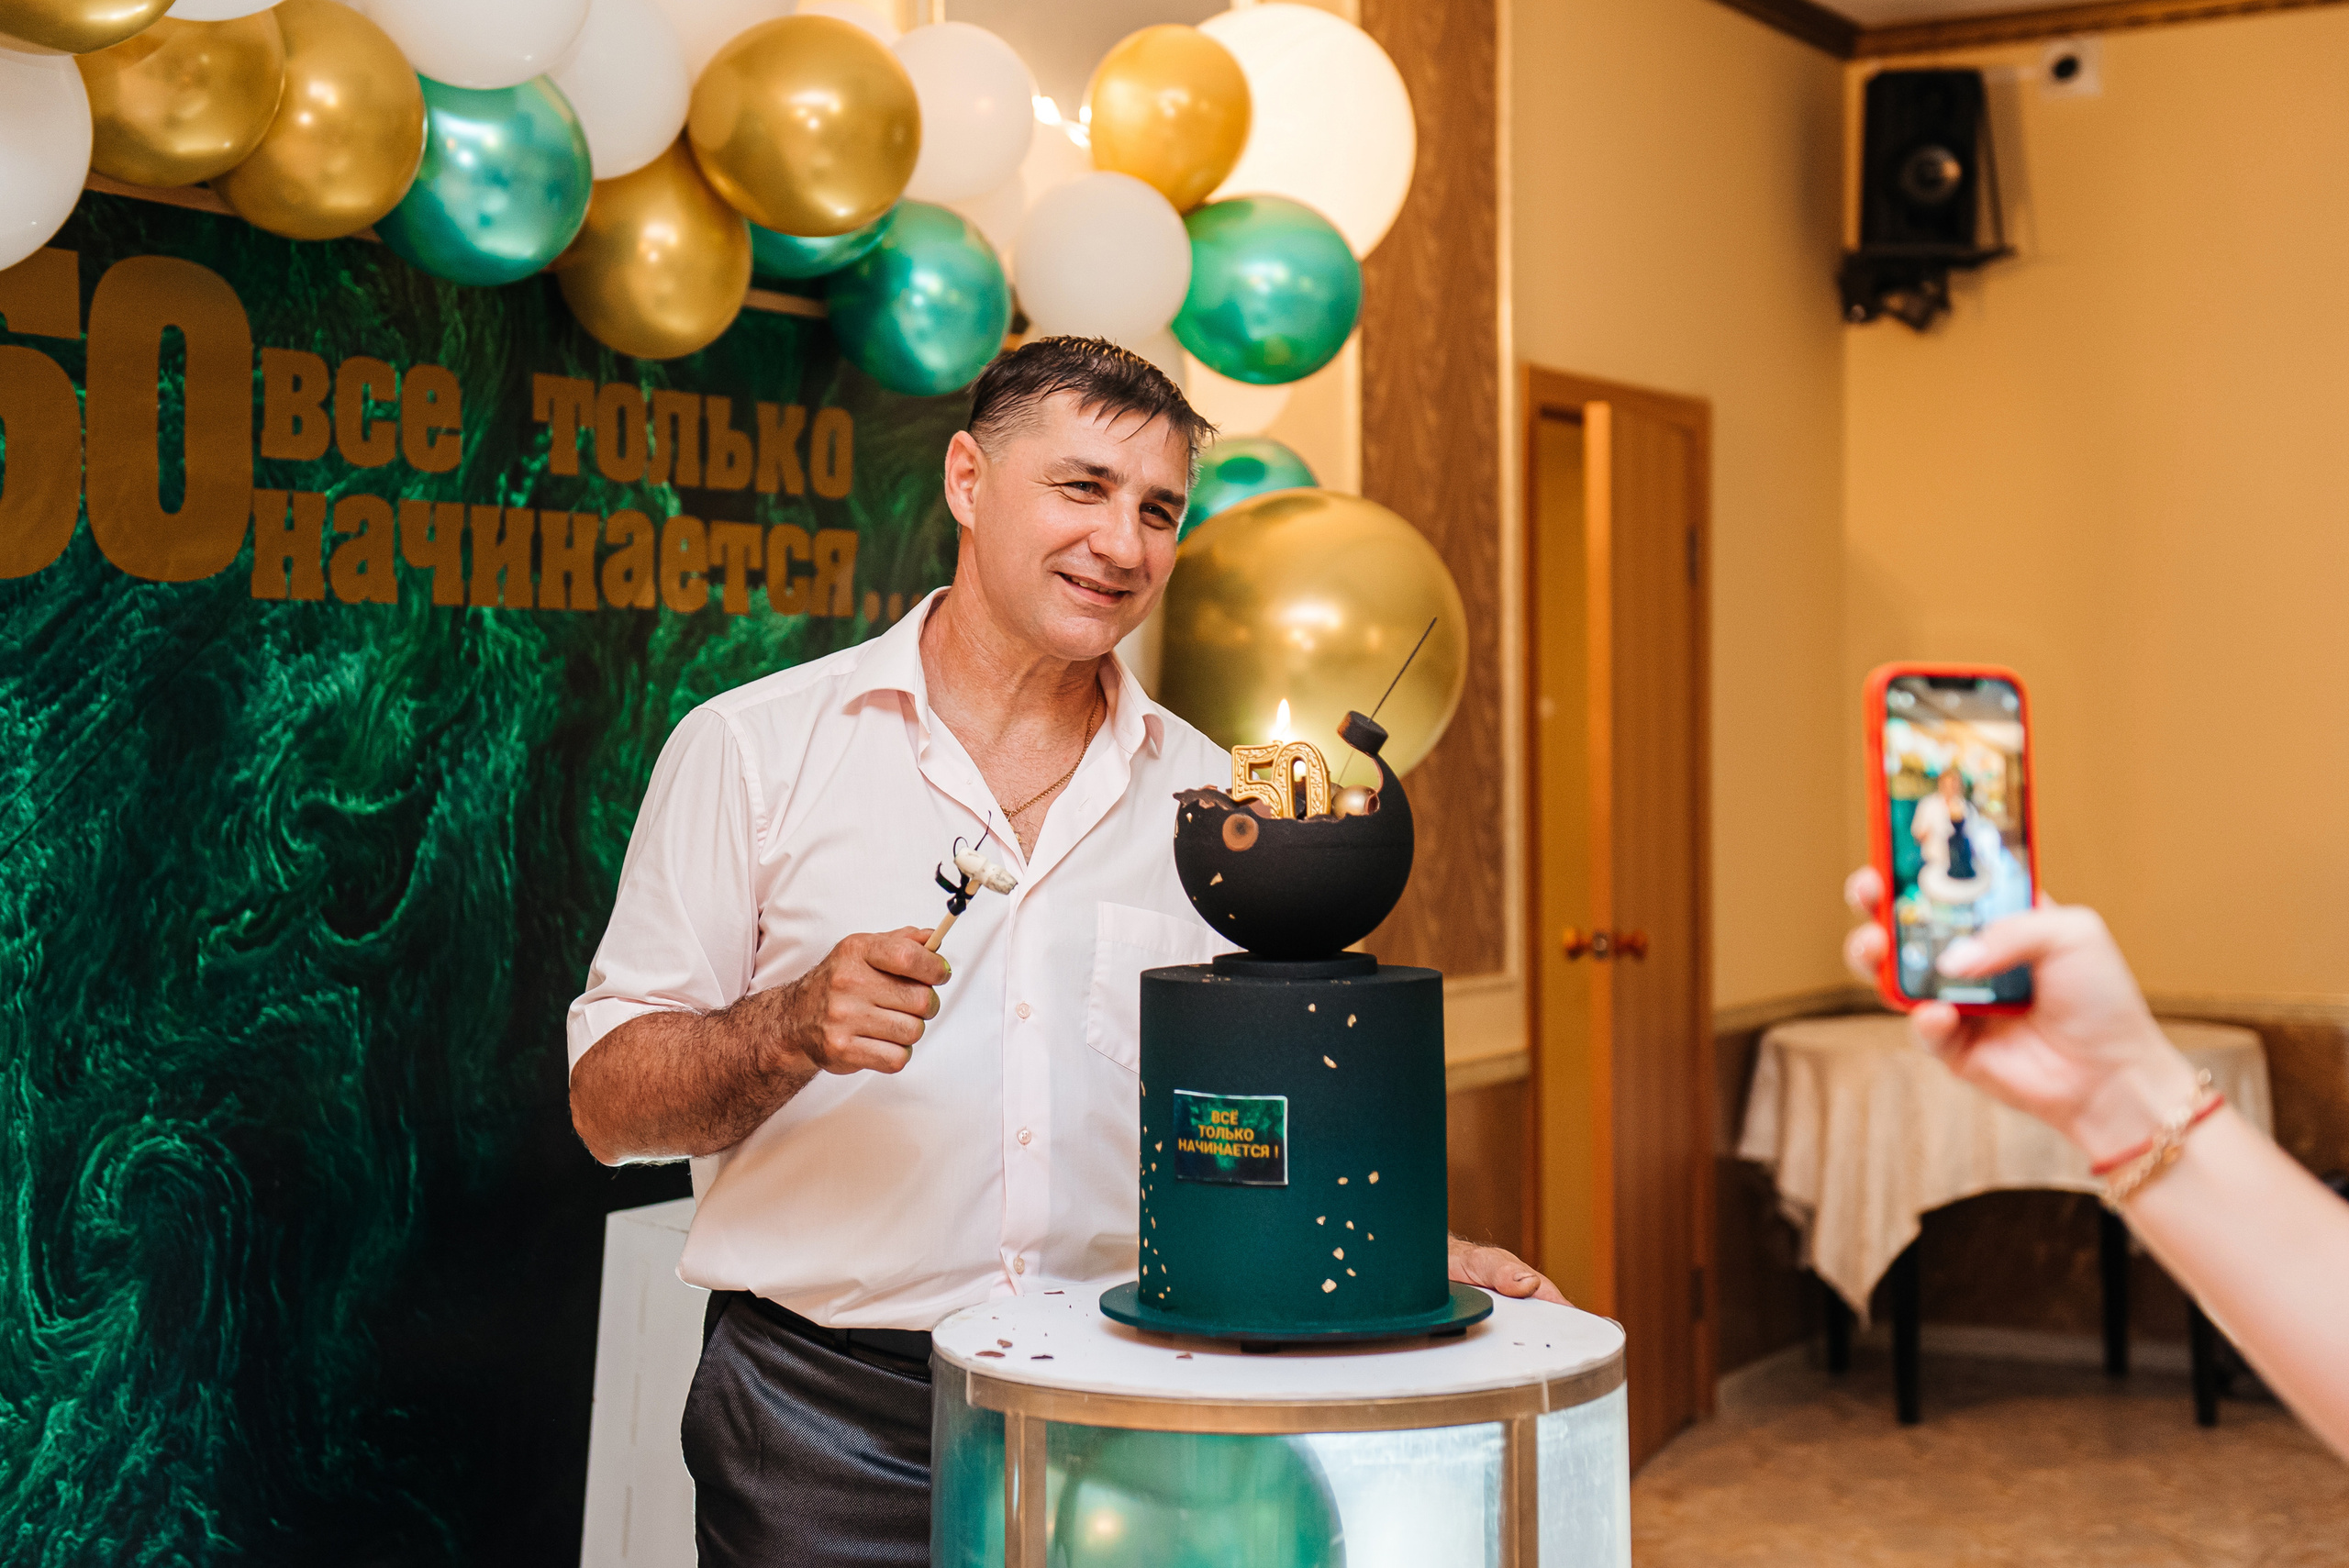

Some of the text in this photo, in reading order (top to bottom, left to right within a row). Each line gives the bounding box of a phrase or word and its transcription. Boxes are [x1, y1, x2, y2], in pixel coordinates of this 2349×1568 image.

[532, 372, 854, 500] только
[1231, 741, 1331, 819] 50
[1178, 1138, 1270, 1158] НАЧИНАЕТСЯ
[1198, 1124, 1254, 1142] ТОЛЬКО
